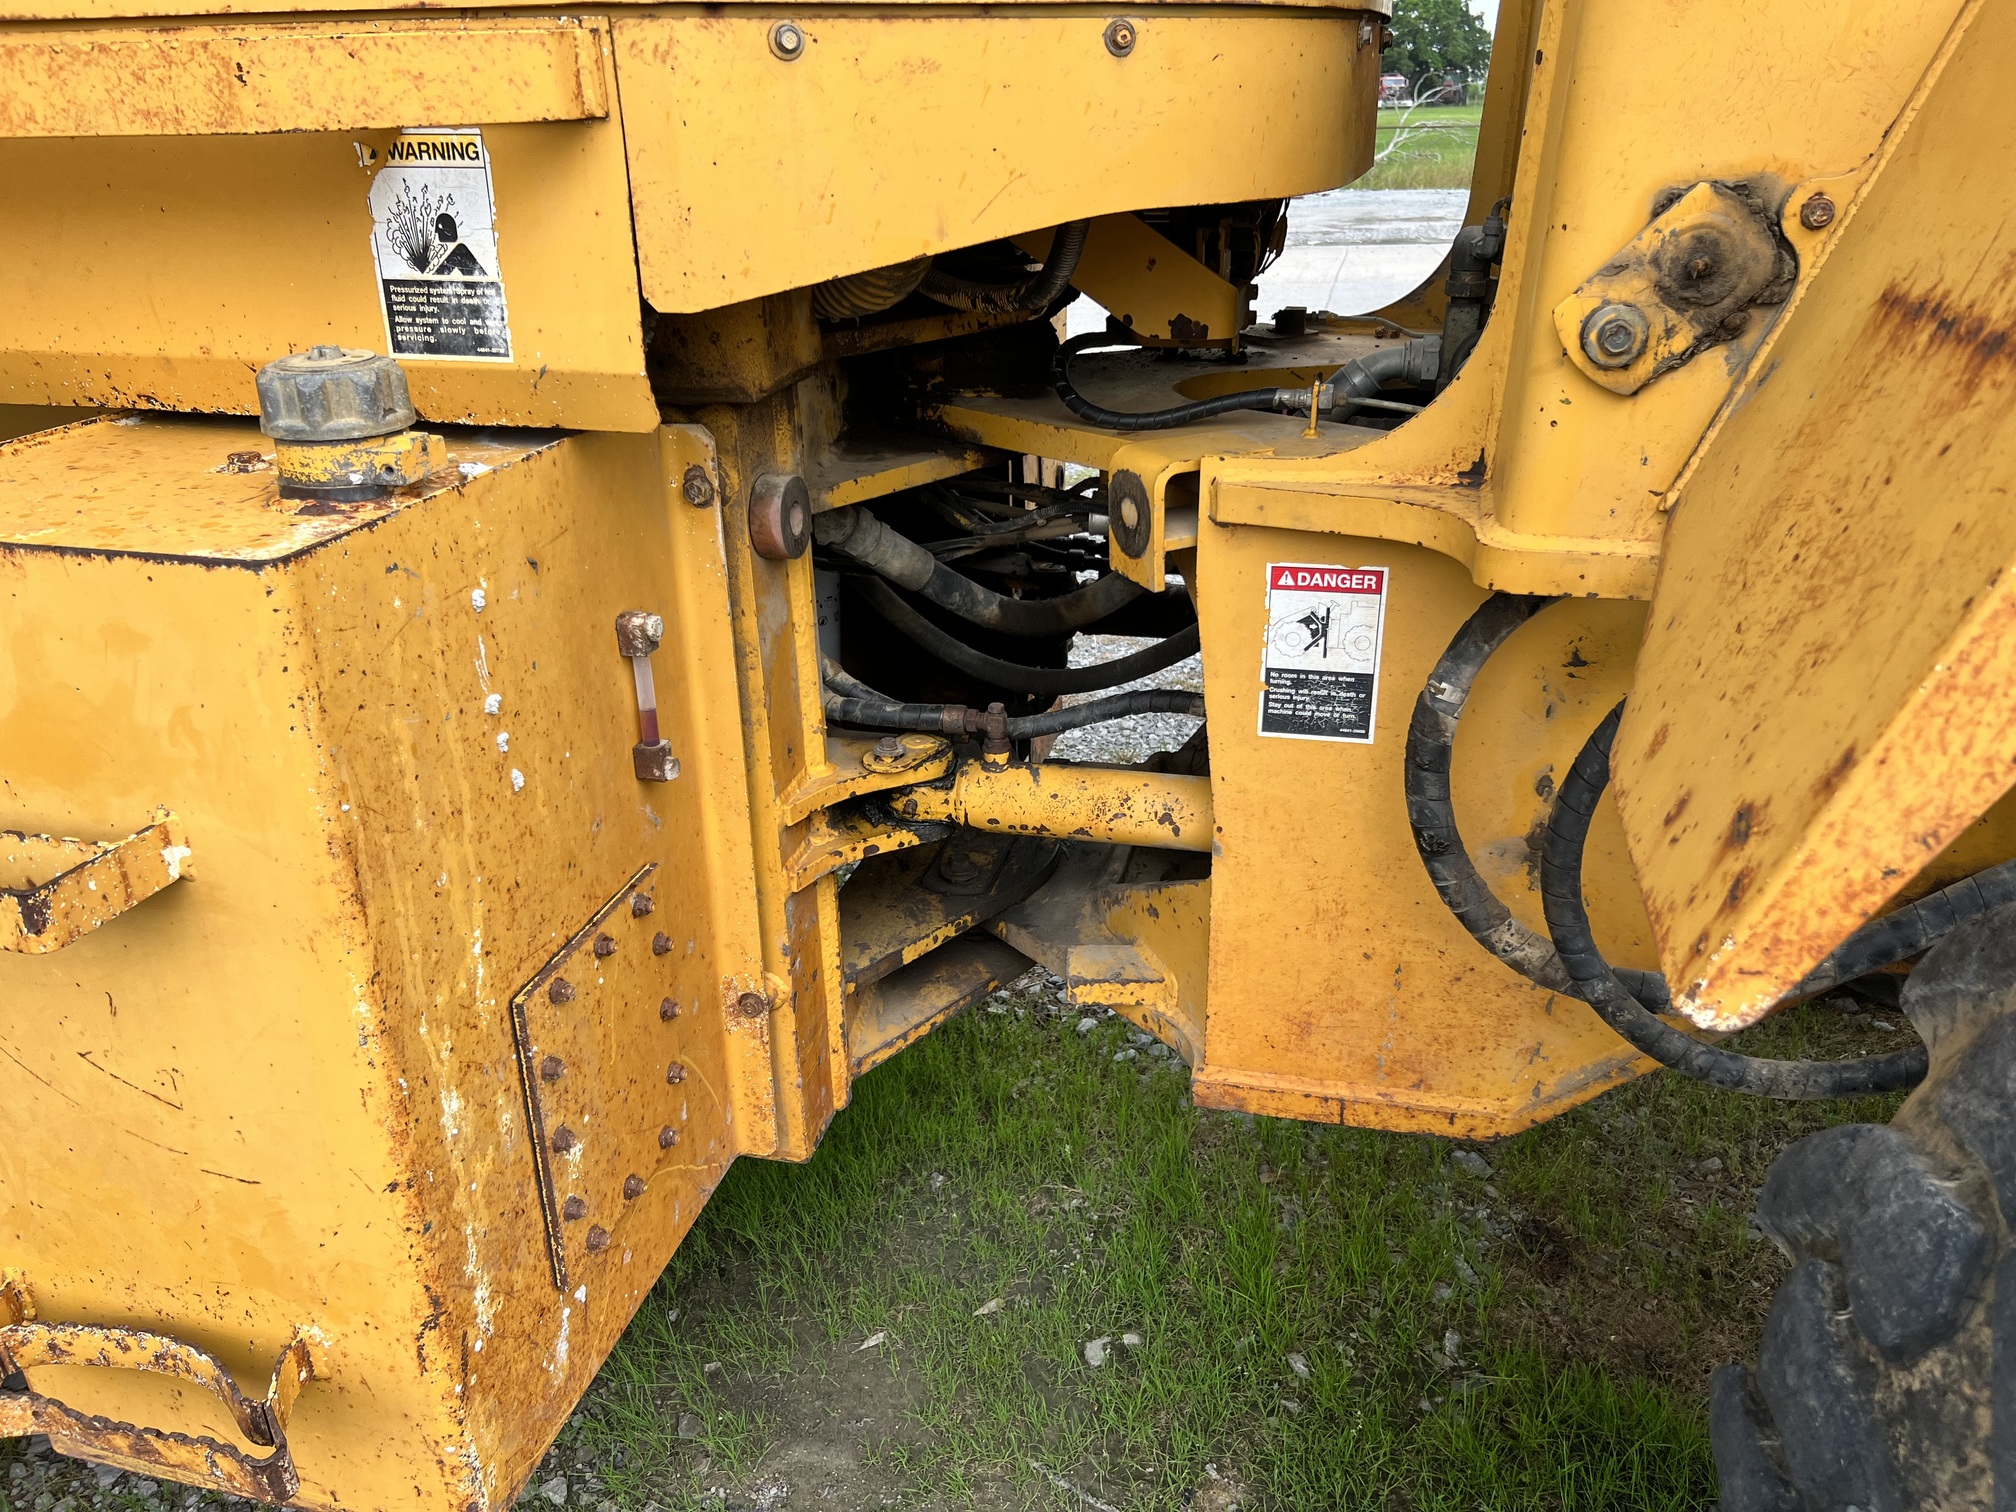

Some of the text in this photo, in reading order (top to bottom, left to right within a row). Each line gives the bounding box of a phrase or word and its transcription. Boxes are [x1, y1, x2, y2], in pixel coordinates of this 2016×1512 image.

[388, 142, 479, 161] WARNING
[390, 285, 428, 294] Pressurized
[456, 287, 474, 296] Spray
[420, 305, 440, 313] injury.
[440, 326, 466, 334] slowly
[474, 327, 501, 335] before
[398, 334, 438, 343] servicing.
[1297, 572, 1377, 589] DANGER
